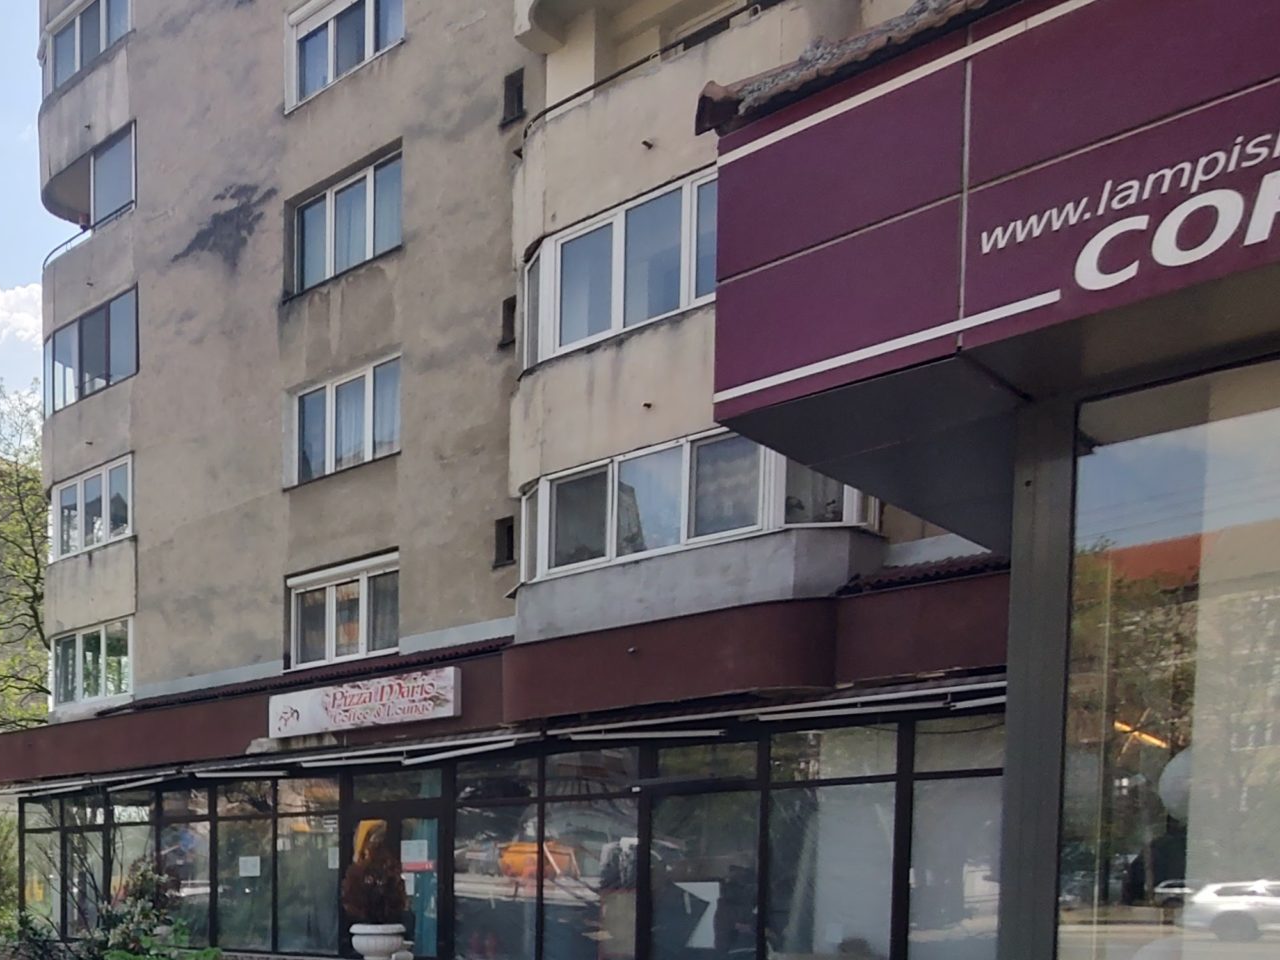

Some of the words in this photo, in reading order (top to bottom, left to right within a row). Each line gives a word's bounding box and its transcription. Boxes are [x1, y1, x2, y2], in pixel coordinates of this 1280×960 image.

[980, 130, 1280, 254] www.lampis
[331, 690, 373, 709] Pizza
[379, 682, 435, 703] Mario
[387, 701, 434, 717] Lounge
